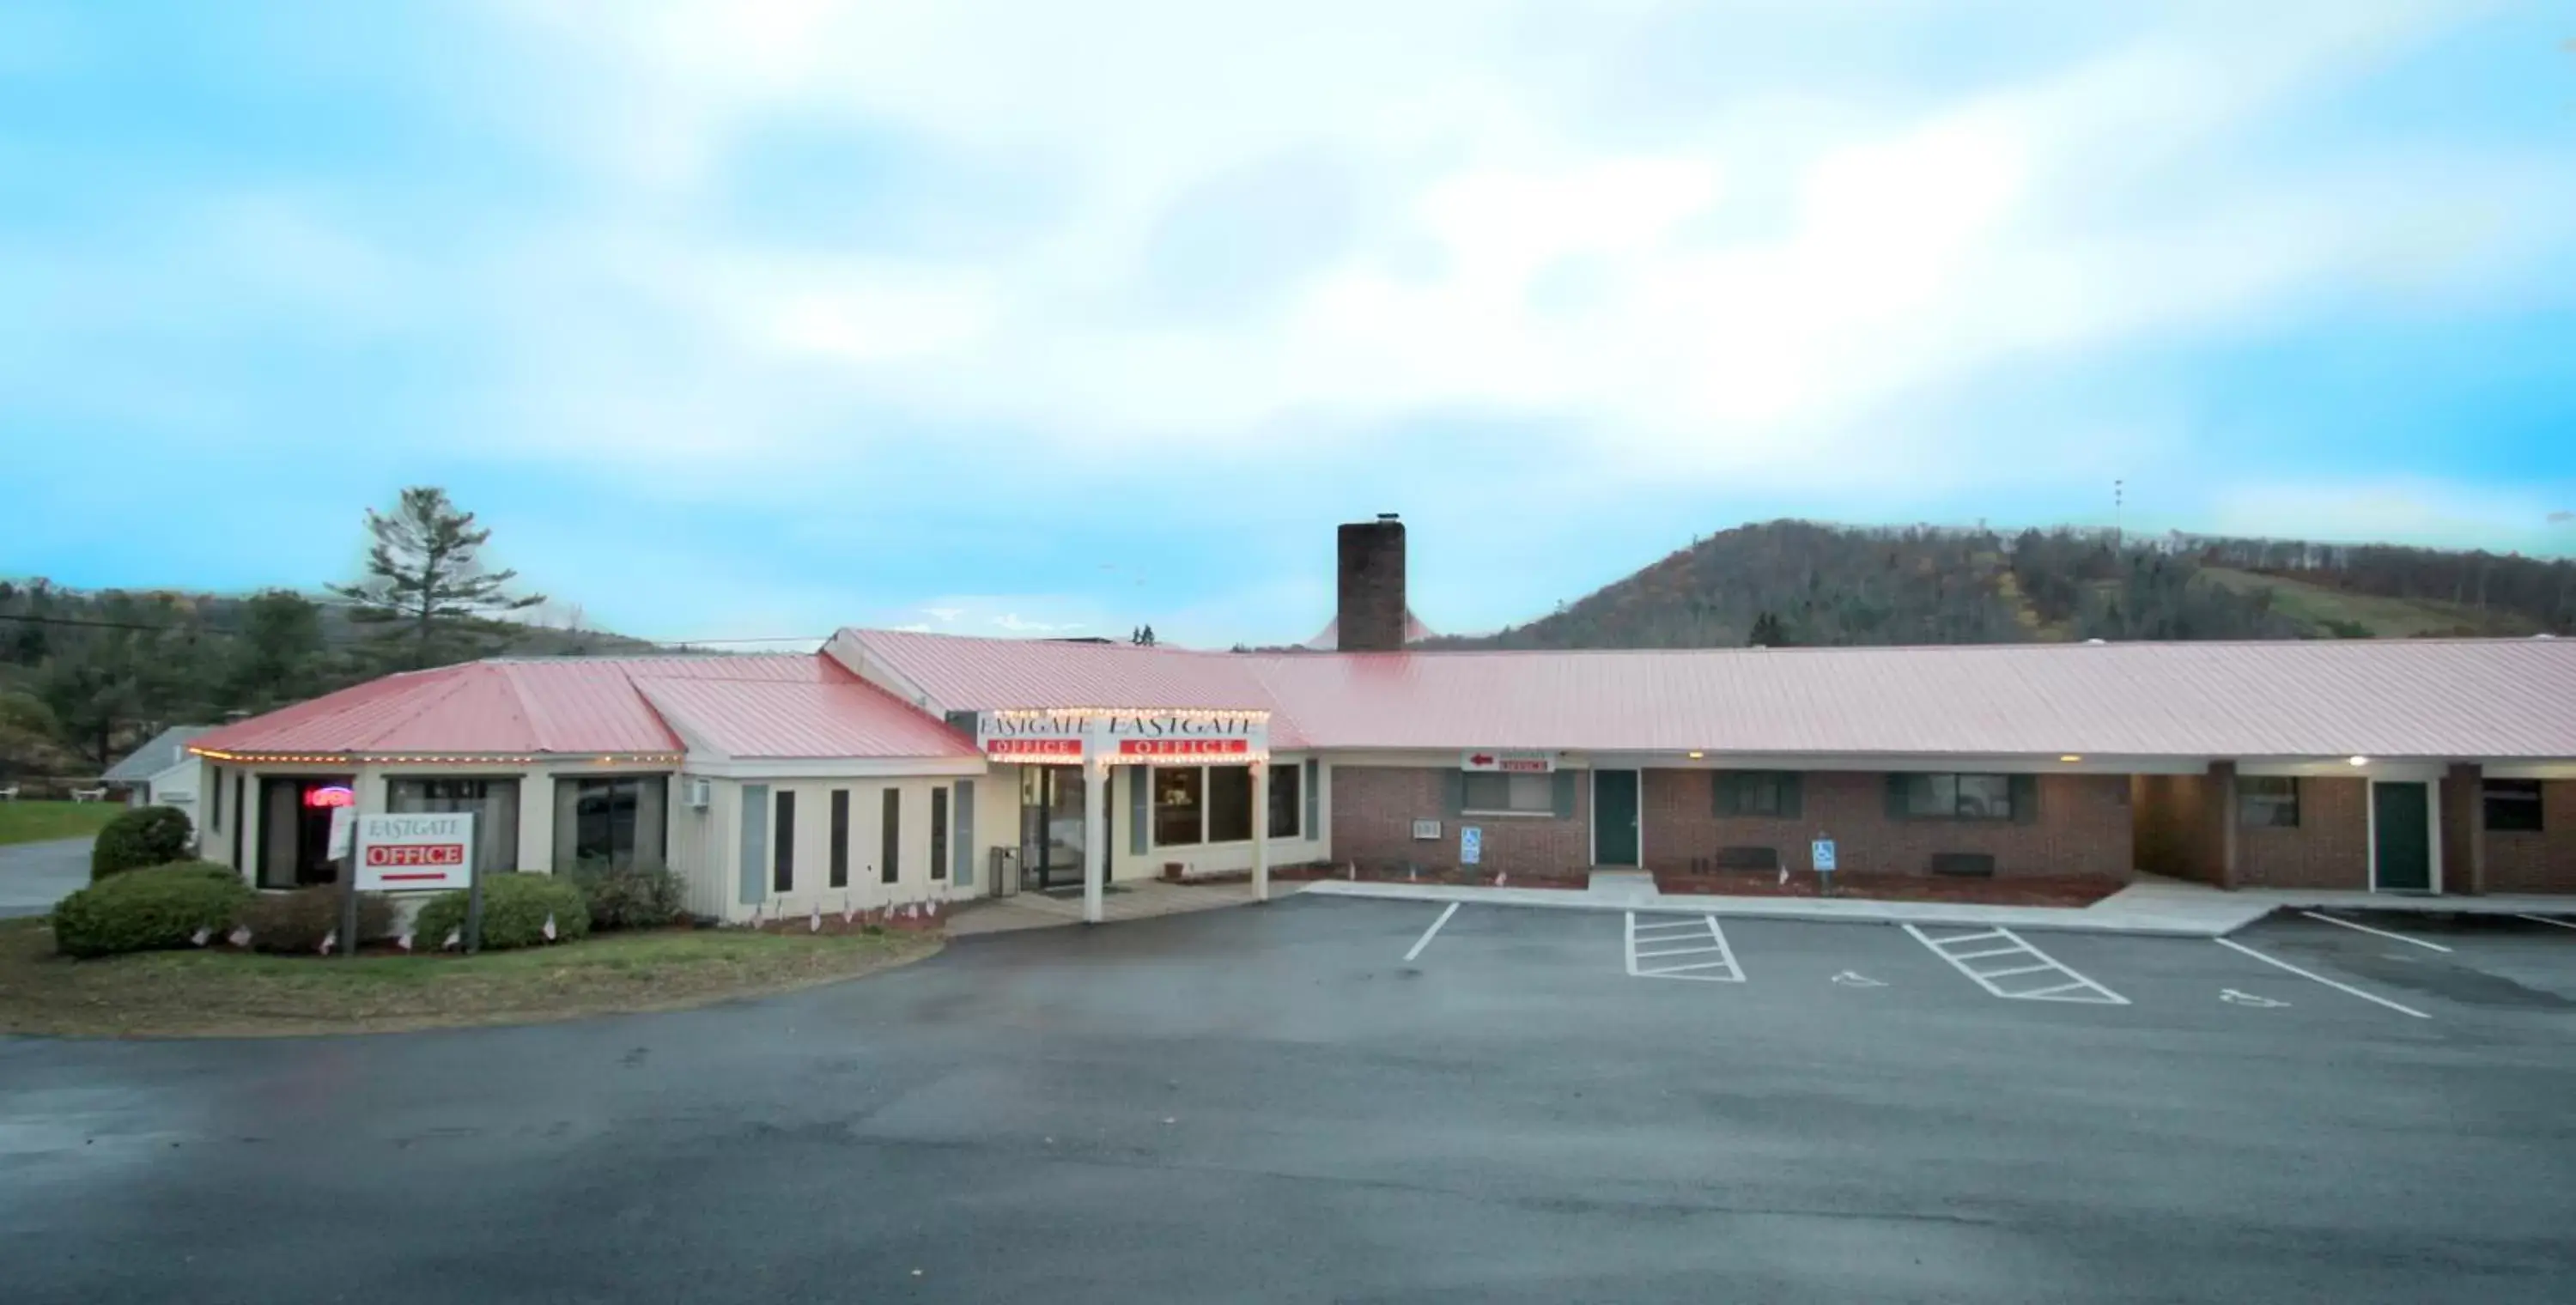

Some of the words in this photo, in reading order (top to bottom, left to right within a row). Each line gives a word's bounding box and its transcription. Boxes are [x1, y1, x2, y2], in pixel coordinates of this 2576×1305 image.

[981, 716, 1092, 736] EASTGATE
[1109, 716, 1257, 737] EASTGATE
[996, 741, 1068, 753] OFFICE
[1134, 741, 1232, 753] OFFICE
[369, 819, 459, 838] EASTGATE
[369, 847, 459, 865] OFFICE
